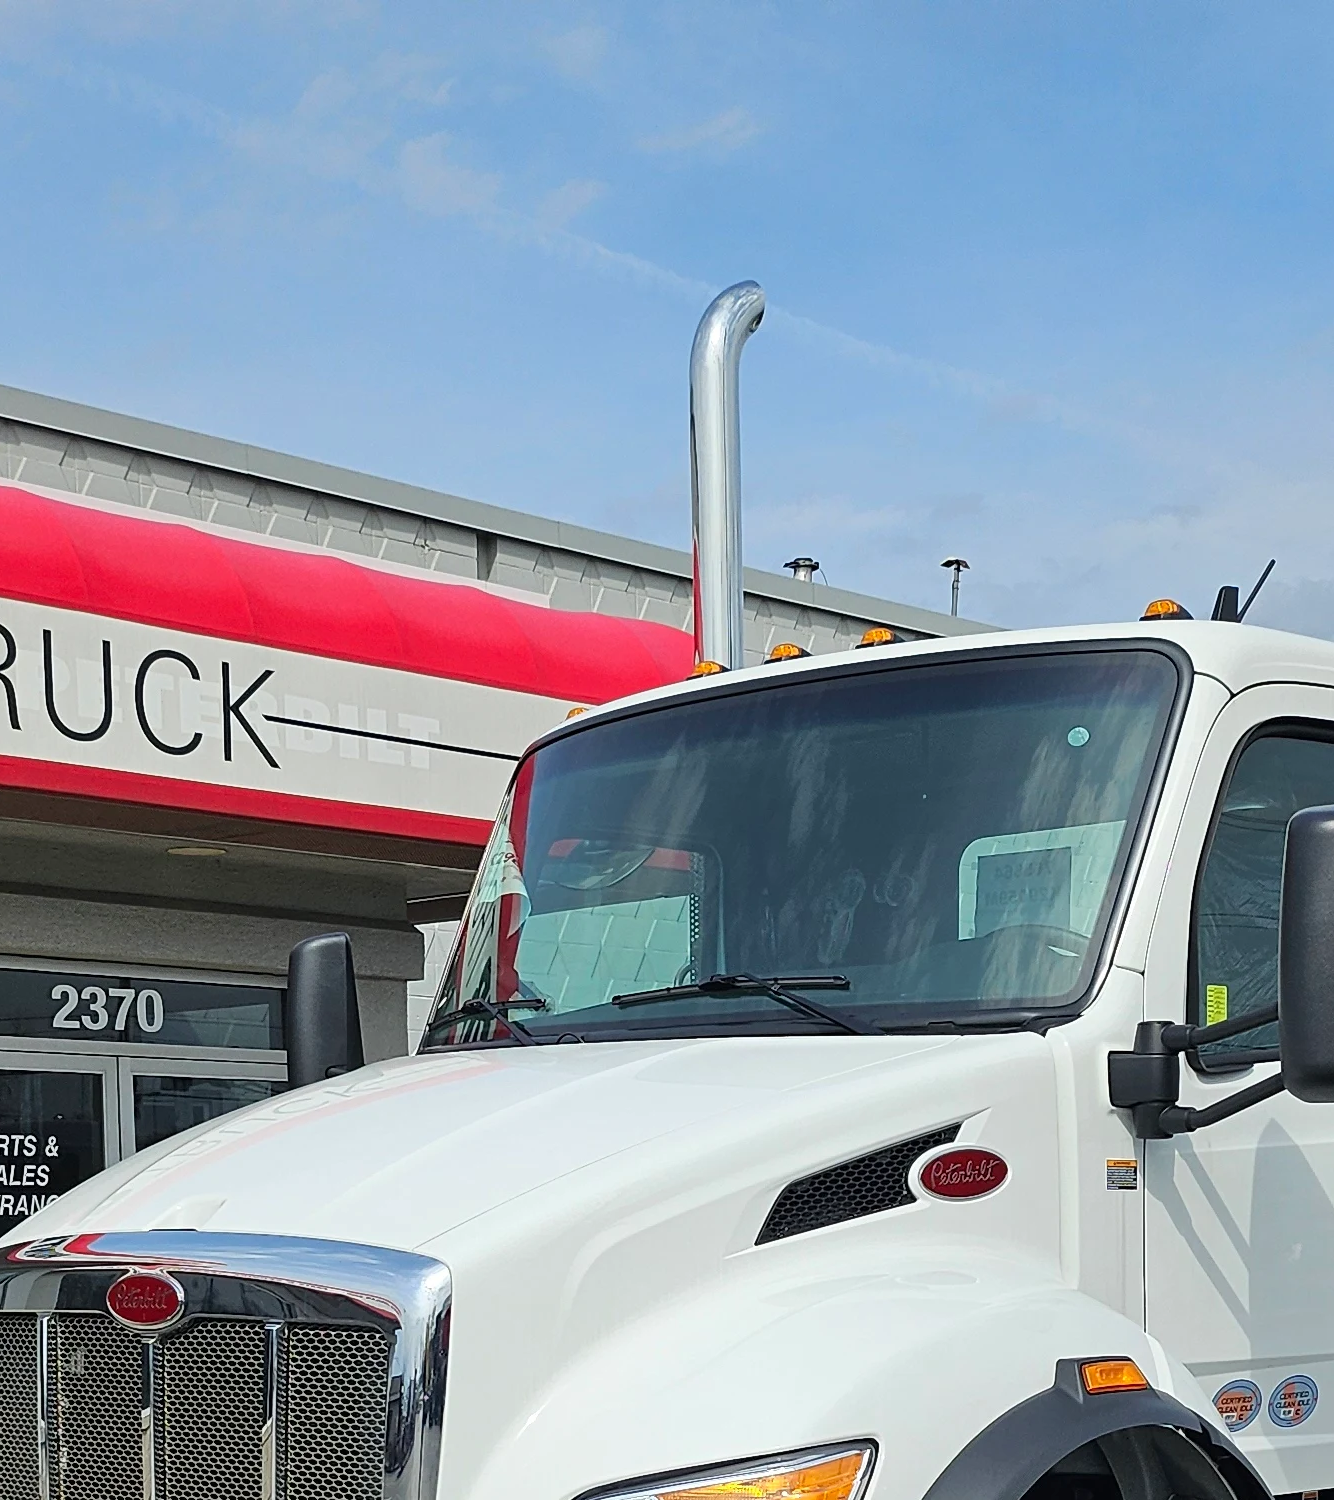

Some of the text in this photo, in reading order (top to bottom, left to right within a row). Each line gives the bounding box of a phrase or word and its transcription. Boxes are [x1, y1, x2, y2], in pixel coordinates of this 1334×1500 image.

[52, 984, 164, 1033] 2370
[45, 1135, 60, 1157] &
[931, 1159, 1001, 1189] Peterbilt
[115, 1283, 174, 1310] Peterbilt
[1221, 1396, 1253, 1405] CERTIFIED
[1275, 1398, 1310, 1408] CLEAN IDLE
[1280, 1390, 1310, 1400] CERTIFIED
[1240, 1403, 1254, 1412] IDLE
